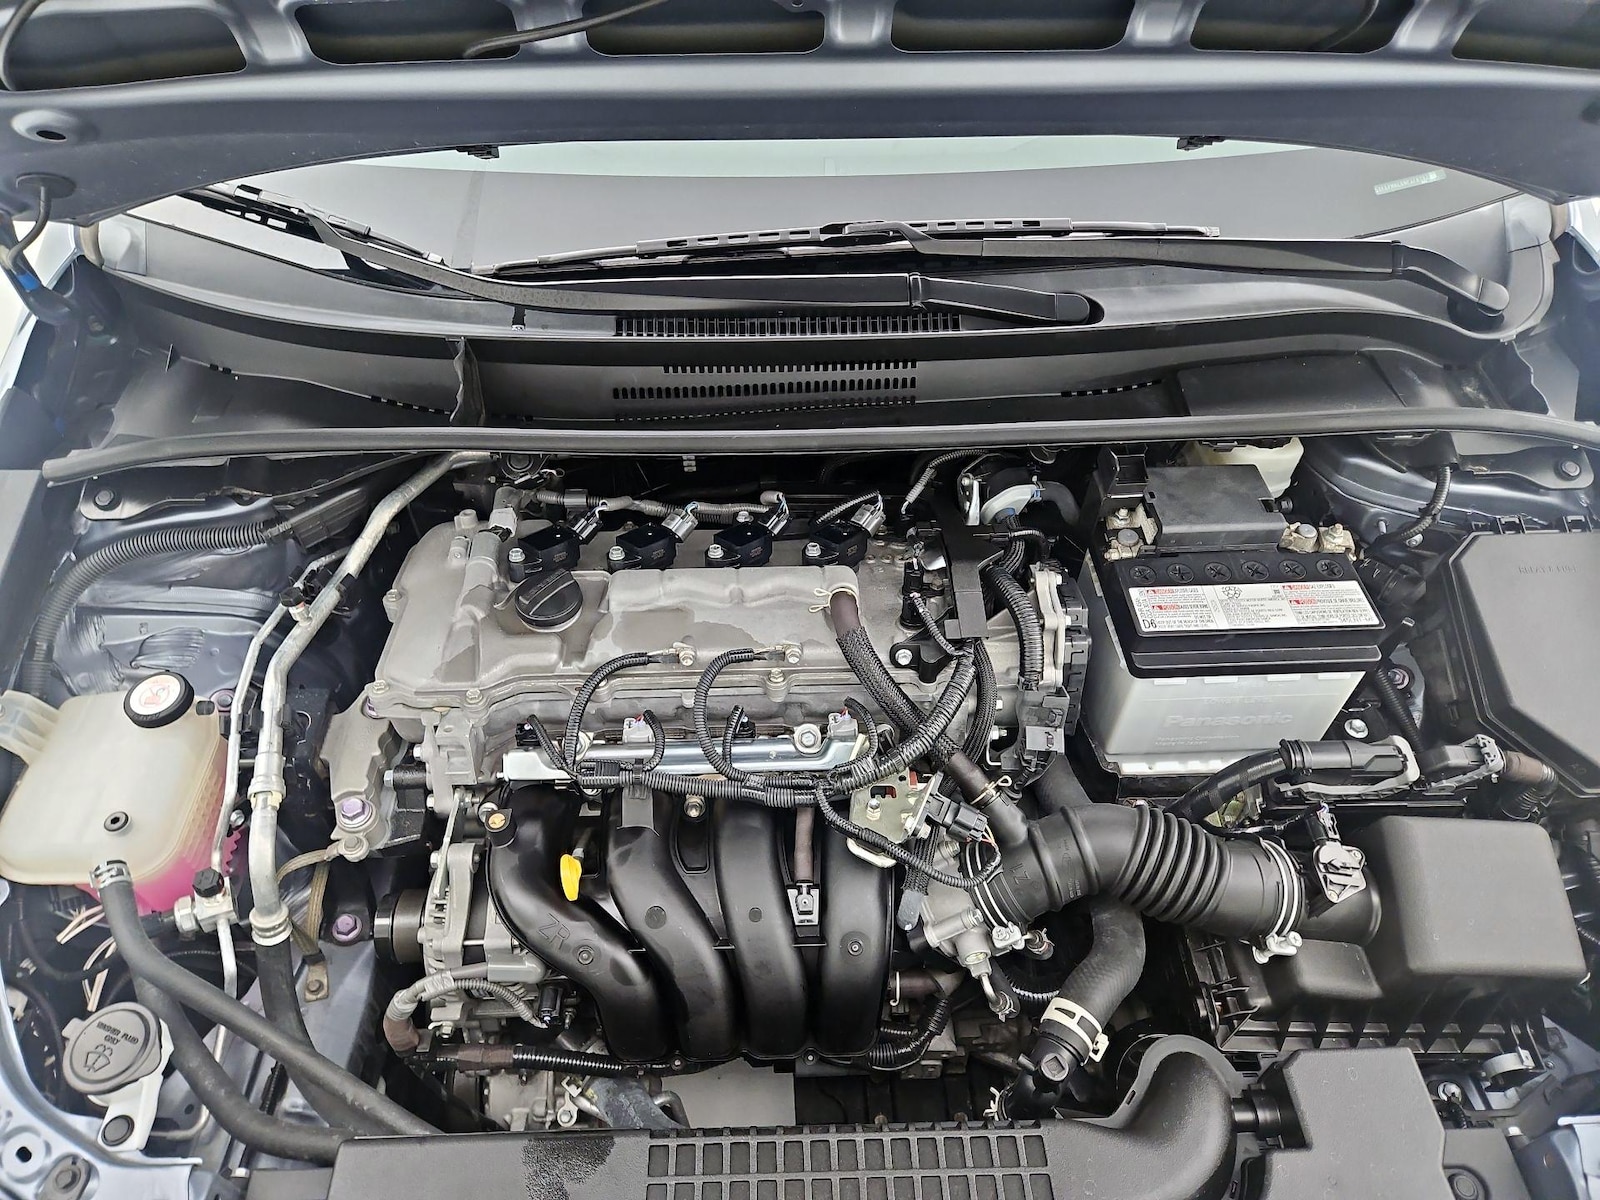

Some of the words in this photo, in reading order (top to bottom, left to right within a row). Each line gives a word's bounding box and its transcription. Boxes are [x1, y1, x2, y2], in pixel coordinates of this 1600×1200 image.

[1142, 619, 1157, 629] D6
[1163, 711, 1294, 728] Panasonic
[538, 912, 571, 950] ZR
